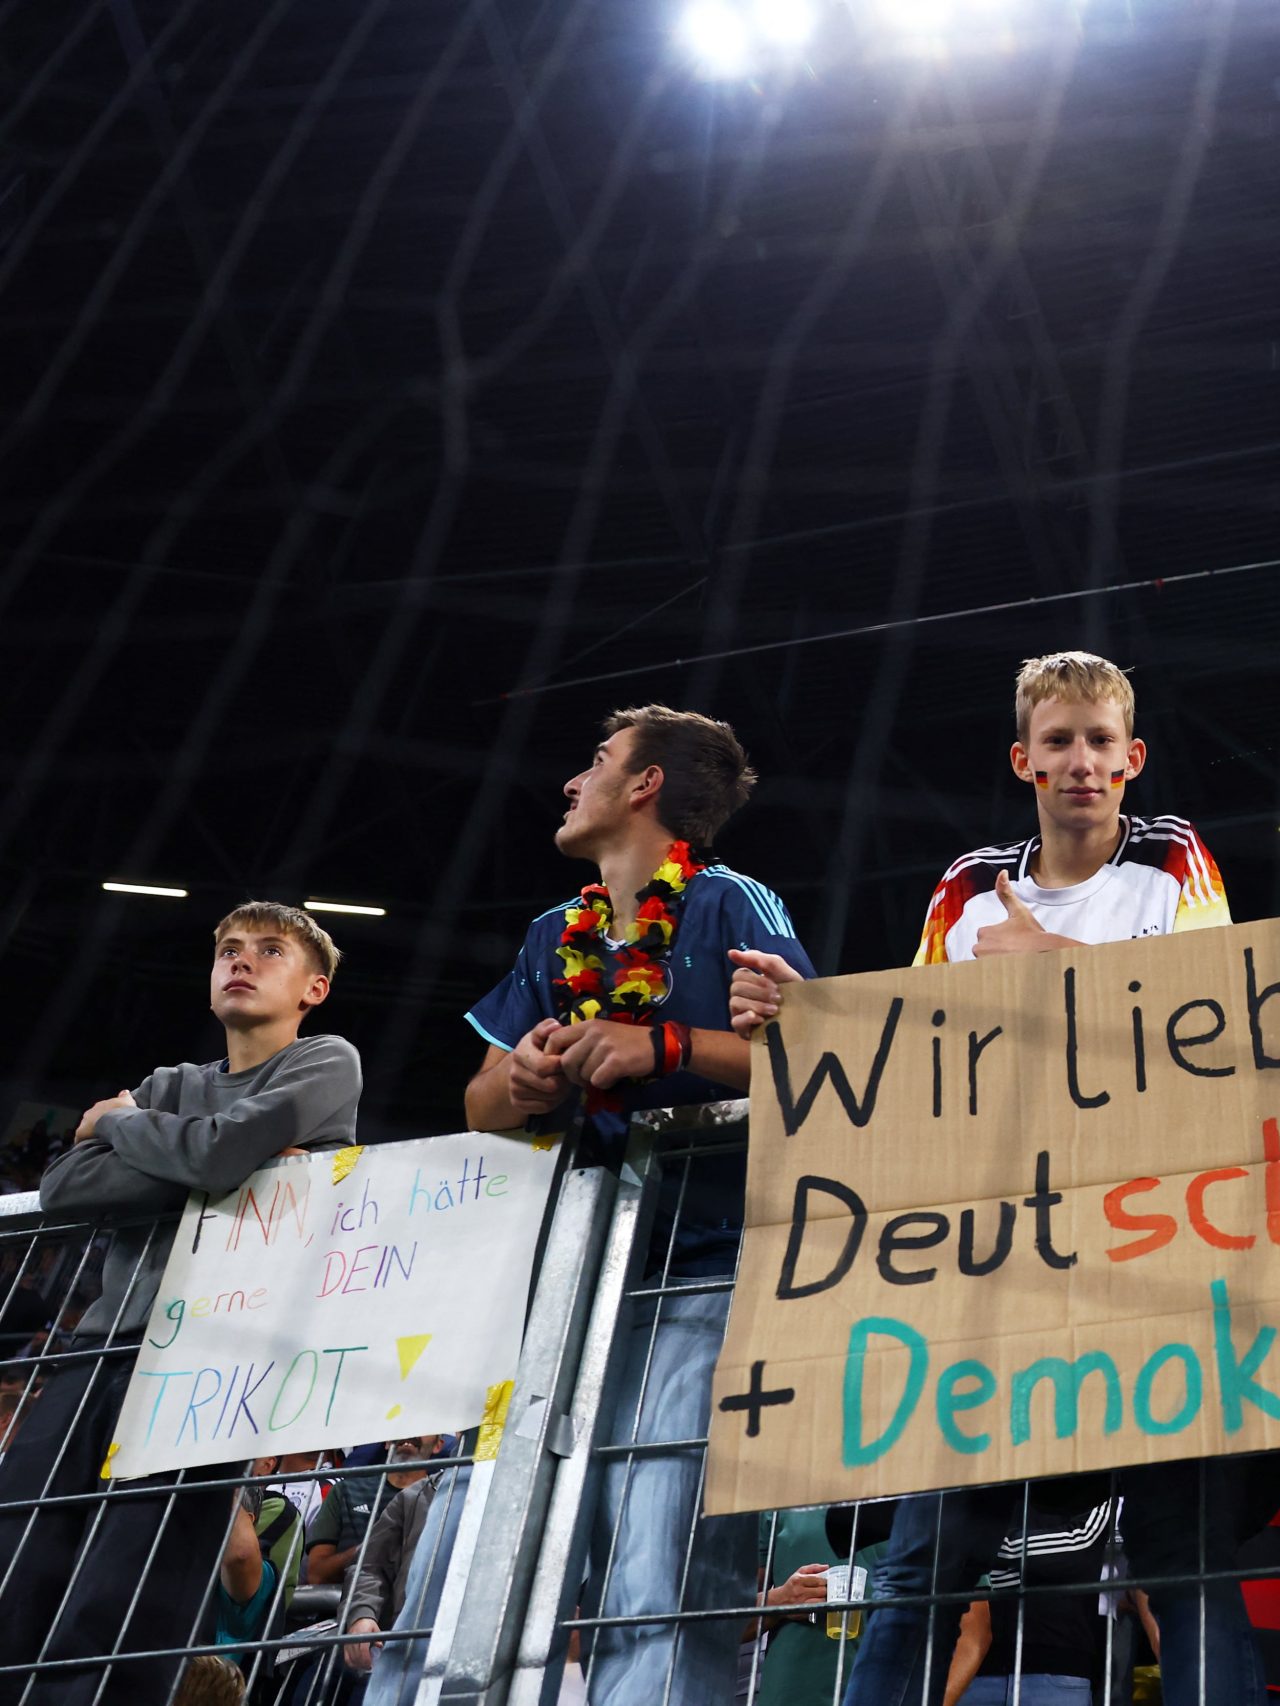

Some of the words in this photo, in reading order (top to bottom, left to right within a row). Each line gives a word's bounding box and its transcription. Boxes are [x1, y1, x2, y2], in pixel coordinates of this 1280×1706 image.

[766, 998, 1003, 1136] Wir
[330, 1178, 379, 1236] ich
[408, 1155, 509, 1217] hätte
[149, 1284, 268, 1349] gerne
[316, 1241, 418, 1298] DEIN
[138, 1345, 369, 1448] TRIKOT
